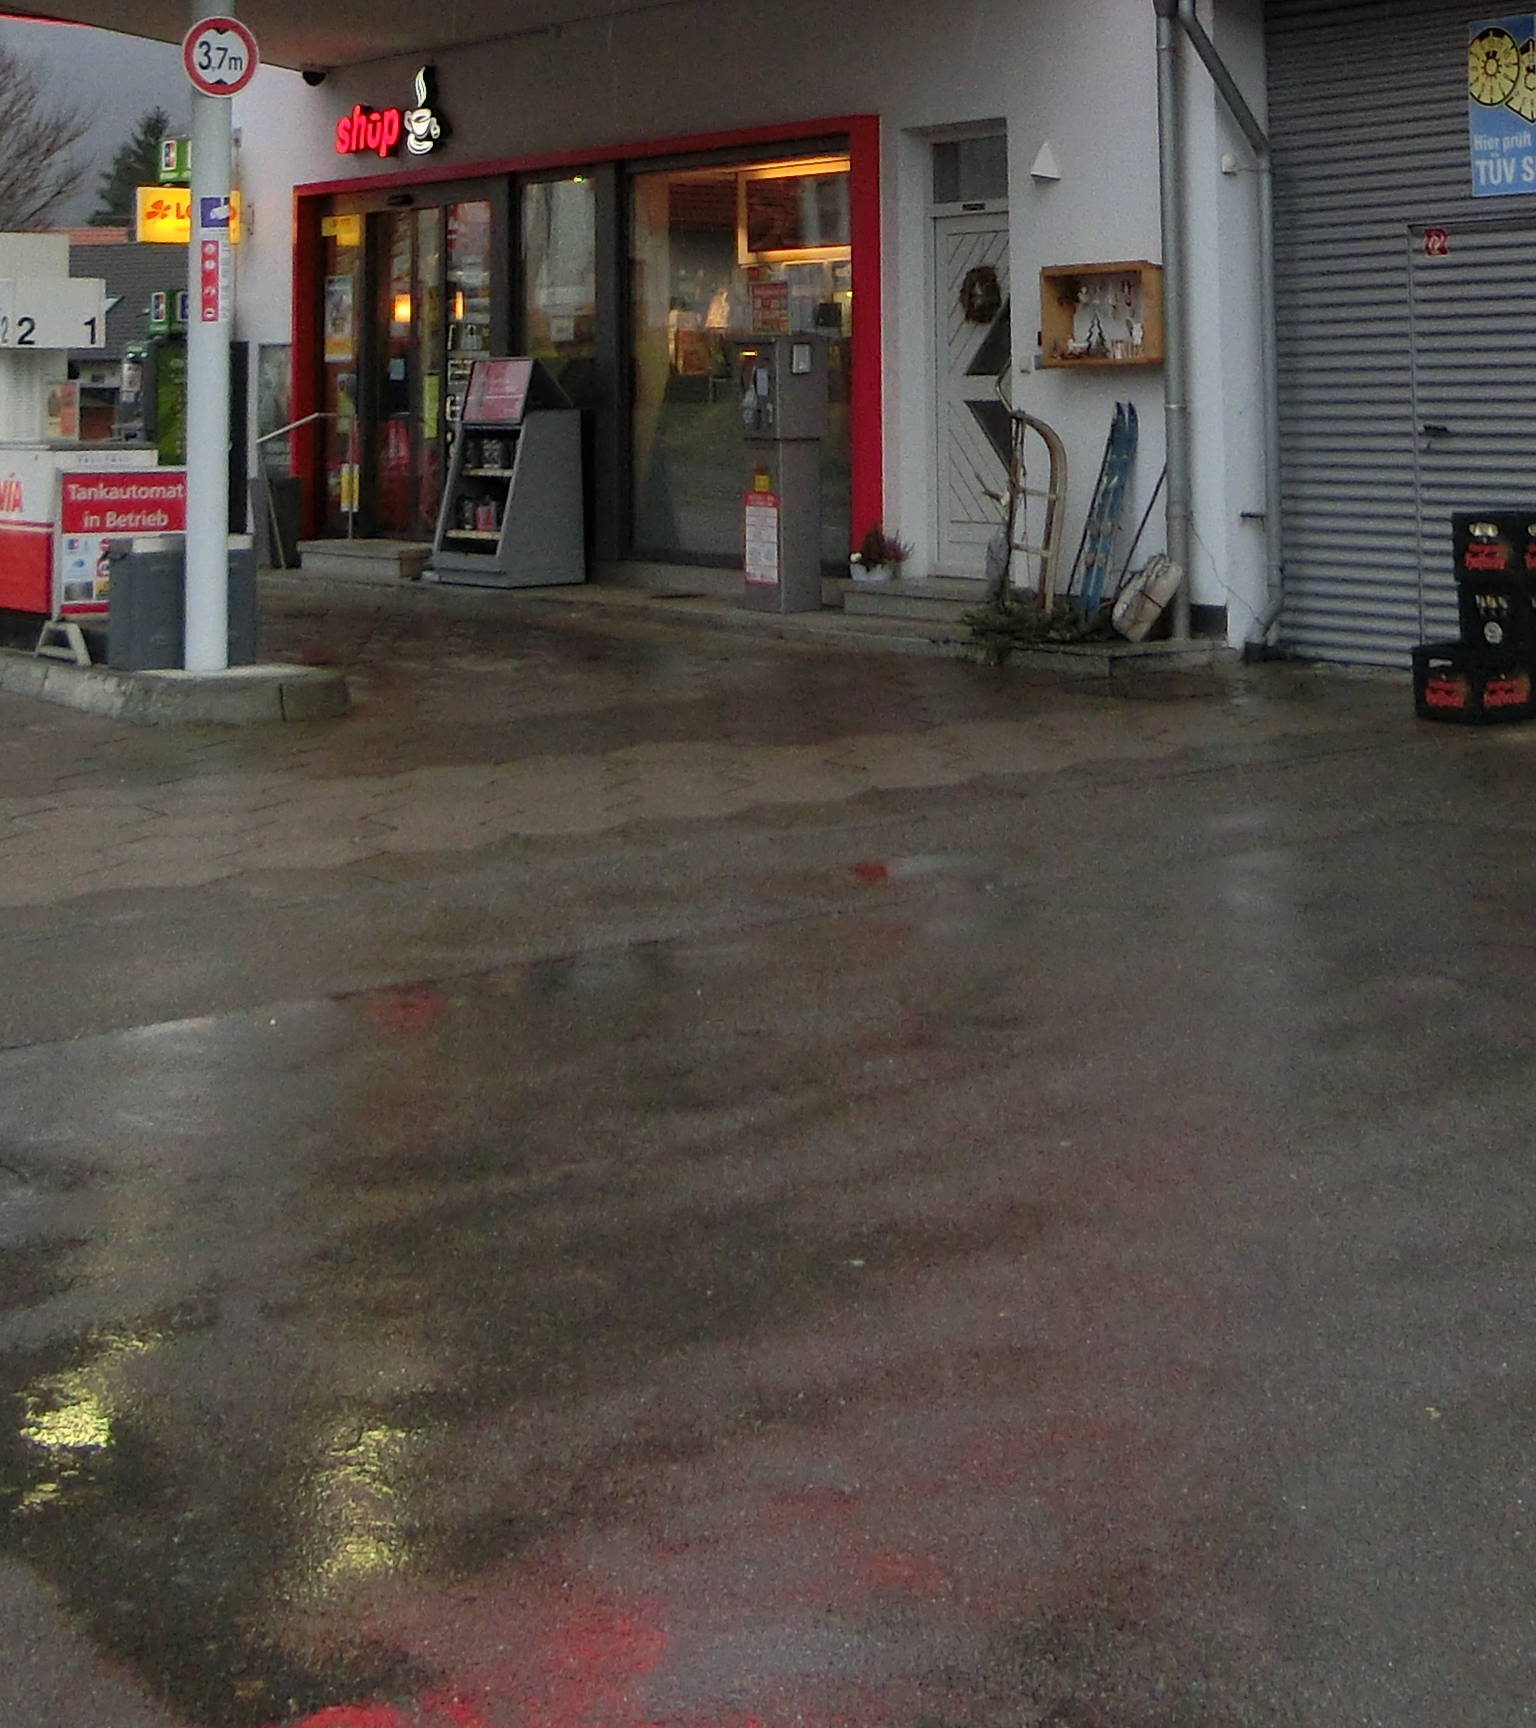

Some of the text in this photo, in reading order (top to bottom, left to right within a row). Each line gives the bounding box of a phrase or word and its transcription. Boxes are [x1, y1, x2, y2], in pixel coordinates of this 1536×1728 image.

[336, 104, 399, 158] shop
[1474, 130, 1532, 153] Hier prüft
[1475, 152, 1515, 186] TÜV
[17, 316, 36, 345] 2
[83, 316, 97, 345] 1
[68, 483, 185, 501] Tankautomat
[83, 509, 168, 528] in Betrieb
